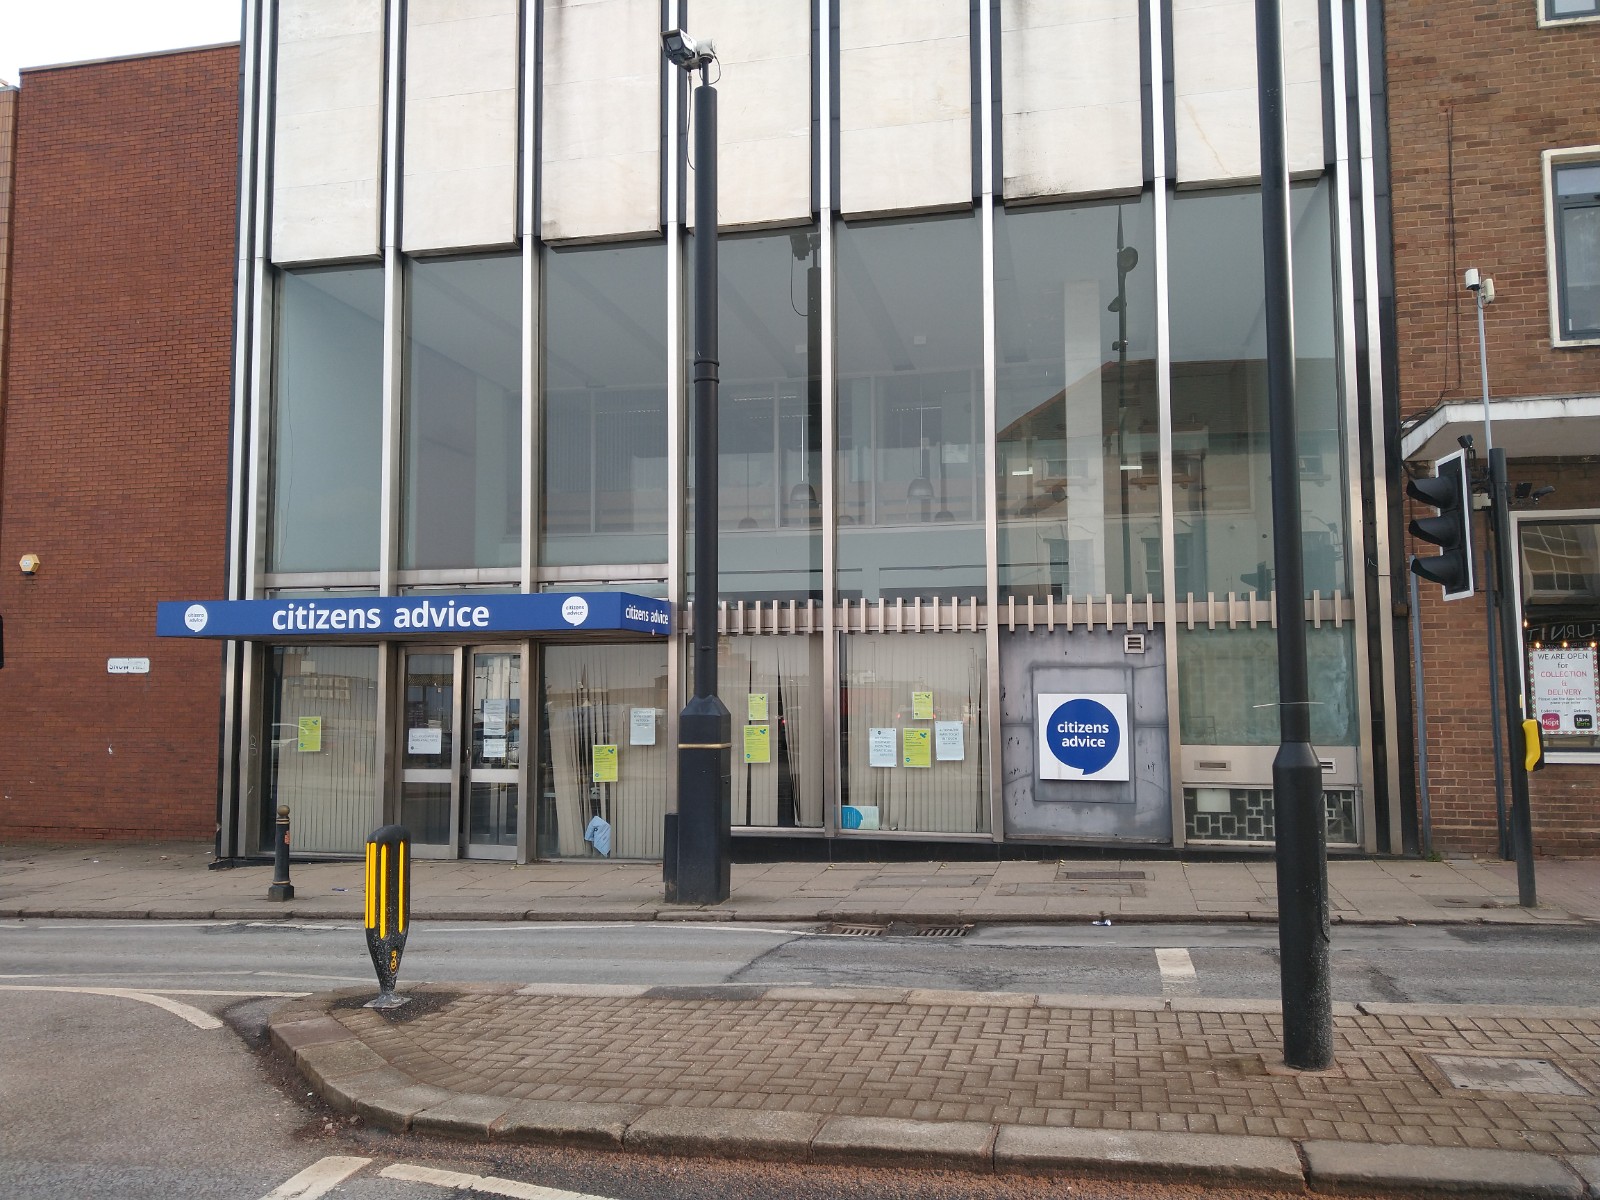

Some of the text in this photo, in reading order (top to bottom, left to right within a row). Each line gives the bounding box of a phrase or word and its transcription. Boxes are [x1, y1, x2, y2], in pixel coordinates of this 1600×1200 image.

[272, 600, 489, 630] citizens advice
[625, 604, 668, 624] citizens advice
[1057, 721, 1109, 733] citizens
[1061, 735, 1106, 747] advice
